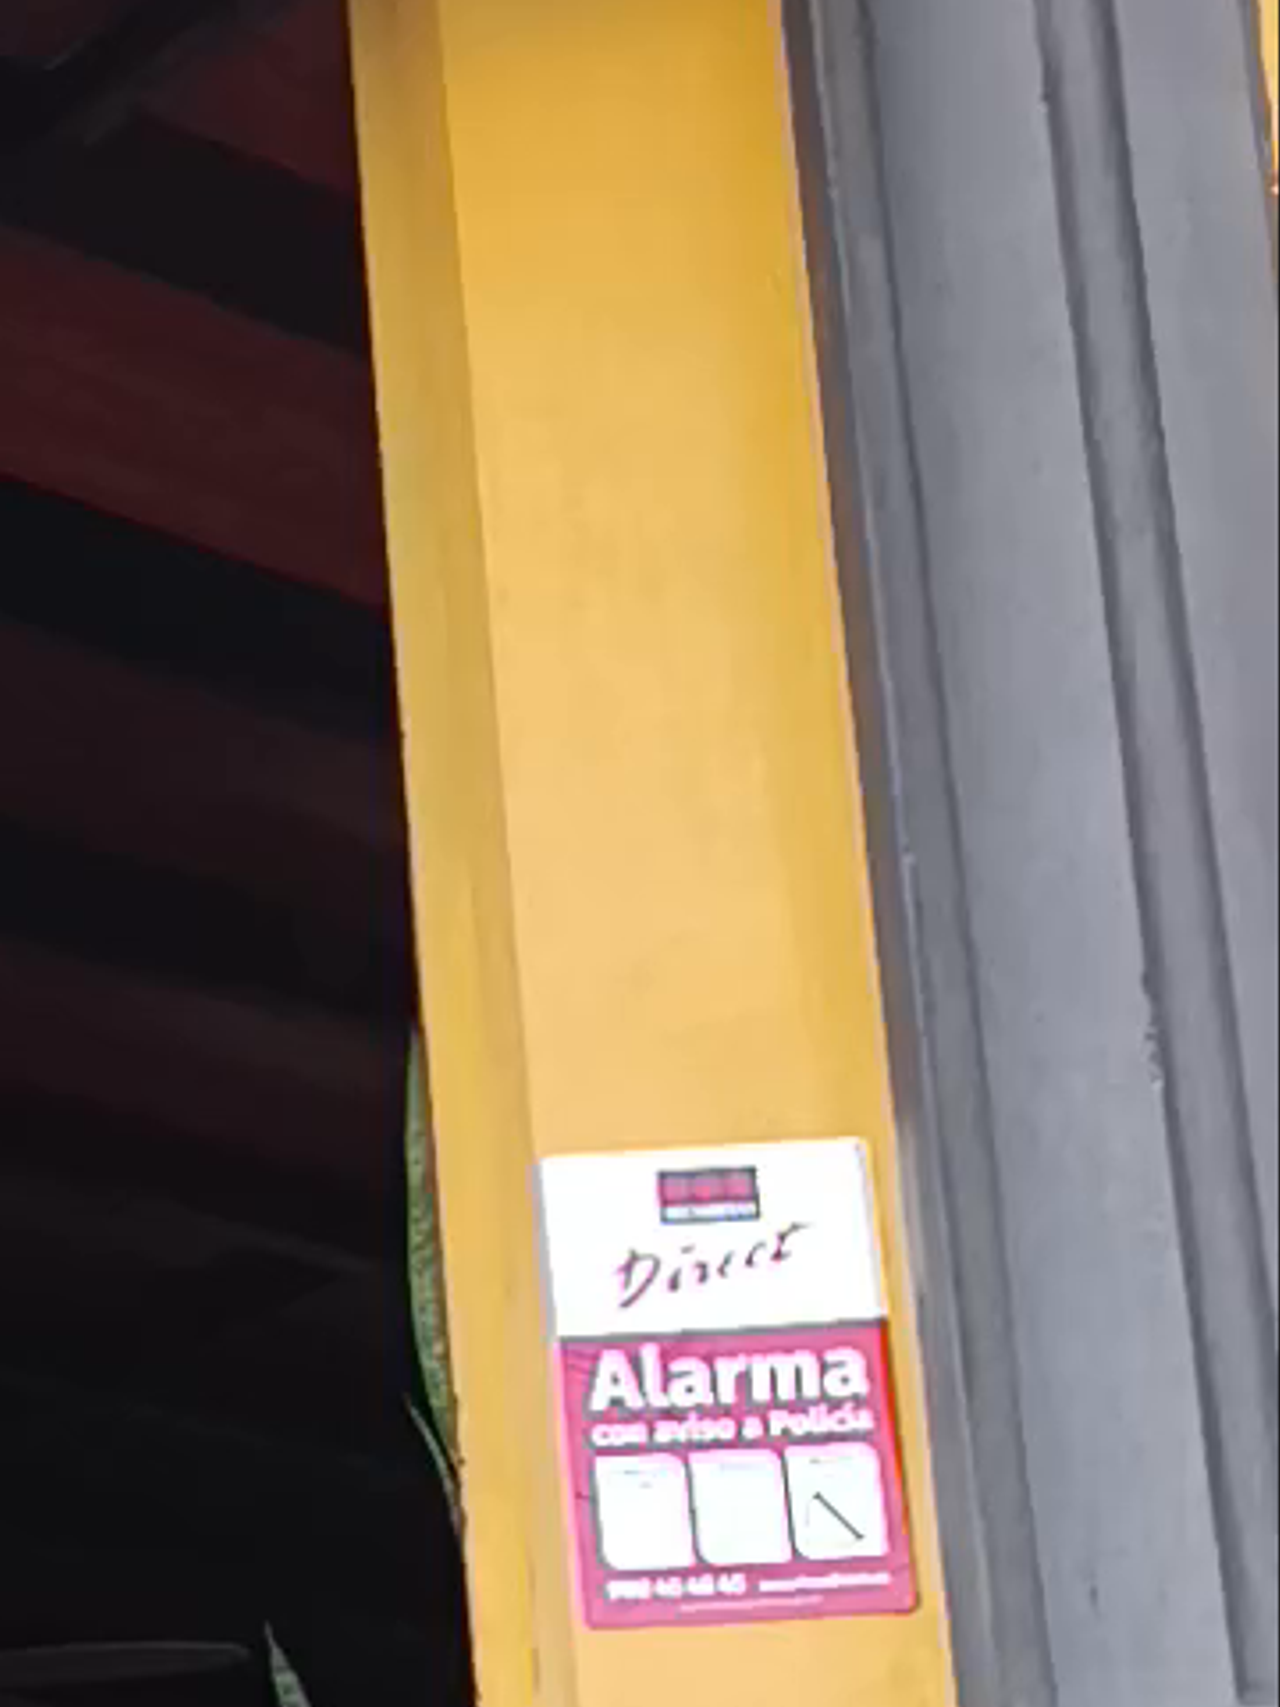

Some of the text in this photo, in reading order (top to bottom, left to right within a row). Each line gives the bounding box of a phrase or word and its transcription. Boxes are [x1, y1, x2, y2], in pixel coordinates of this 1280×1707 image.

[590, 1342, 870, 1411] Alarma
[591, 1422, 648, 1447] con
[652, 1412, 736, 1444] aviso
[741, 1415, 764, 1439] a
